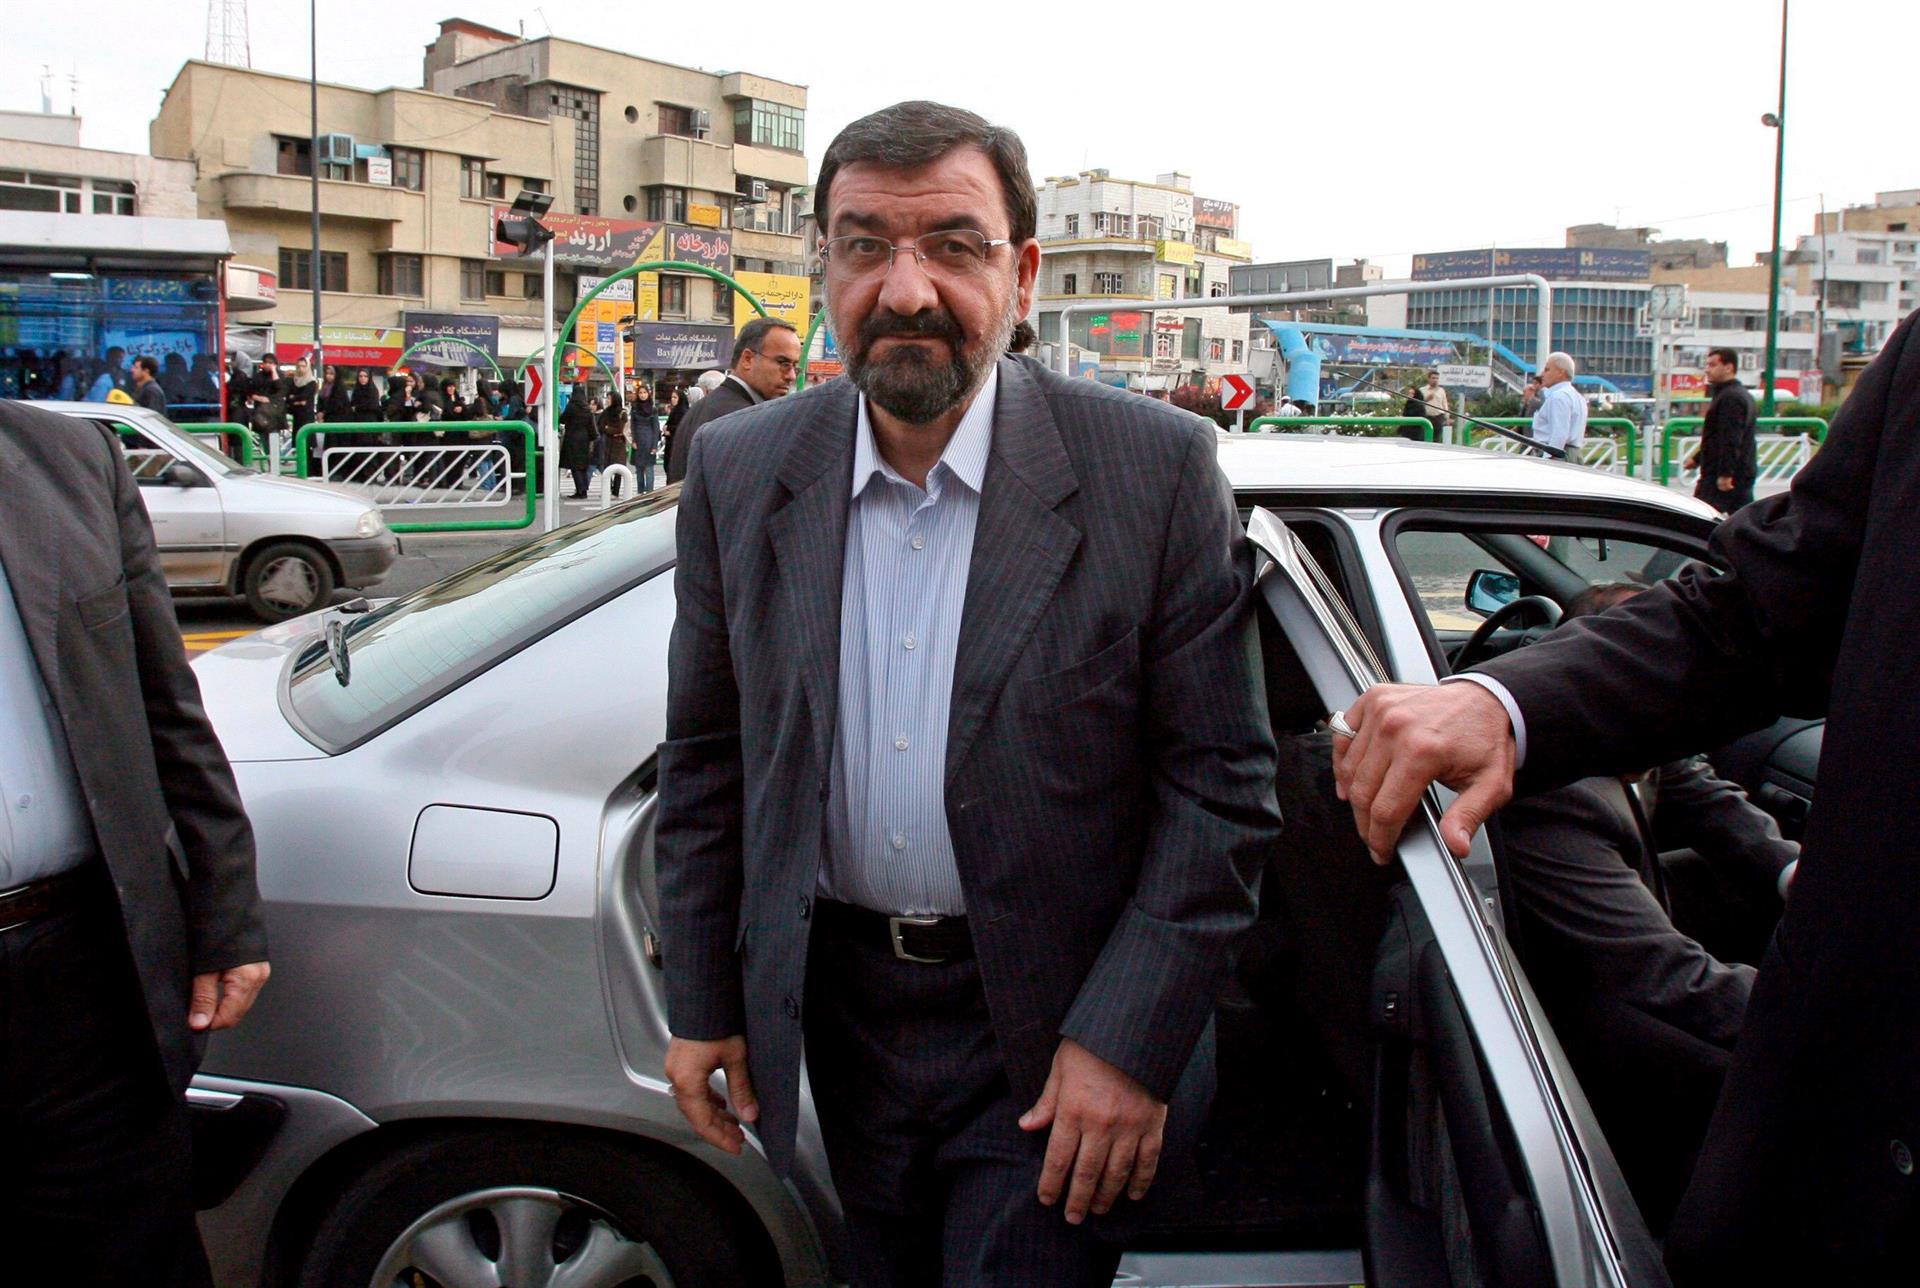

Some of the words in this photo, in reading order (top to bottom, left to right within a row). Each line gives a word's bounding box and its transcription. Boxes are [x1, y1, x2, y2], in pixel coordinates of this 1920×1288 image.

[569, 227, 611, 252] اروند
[677, 232, 729, 259] داروخانه
[768, 291, 804, 300] دارالترجمه
[412, 324, 432, 337] بیات
[434, 325, 454, 338] کتاب
[456, 325, 492, 339] نمایشگاه
[655, 333, 671, 344] بیات
[672, 333, 688, 343] کتاب
[689, 334, 717, 345] نمایشگاه
[1442, 366, 1464, 377] انقلاب
[1465, 368, 1487, 377] میدان
